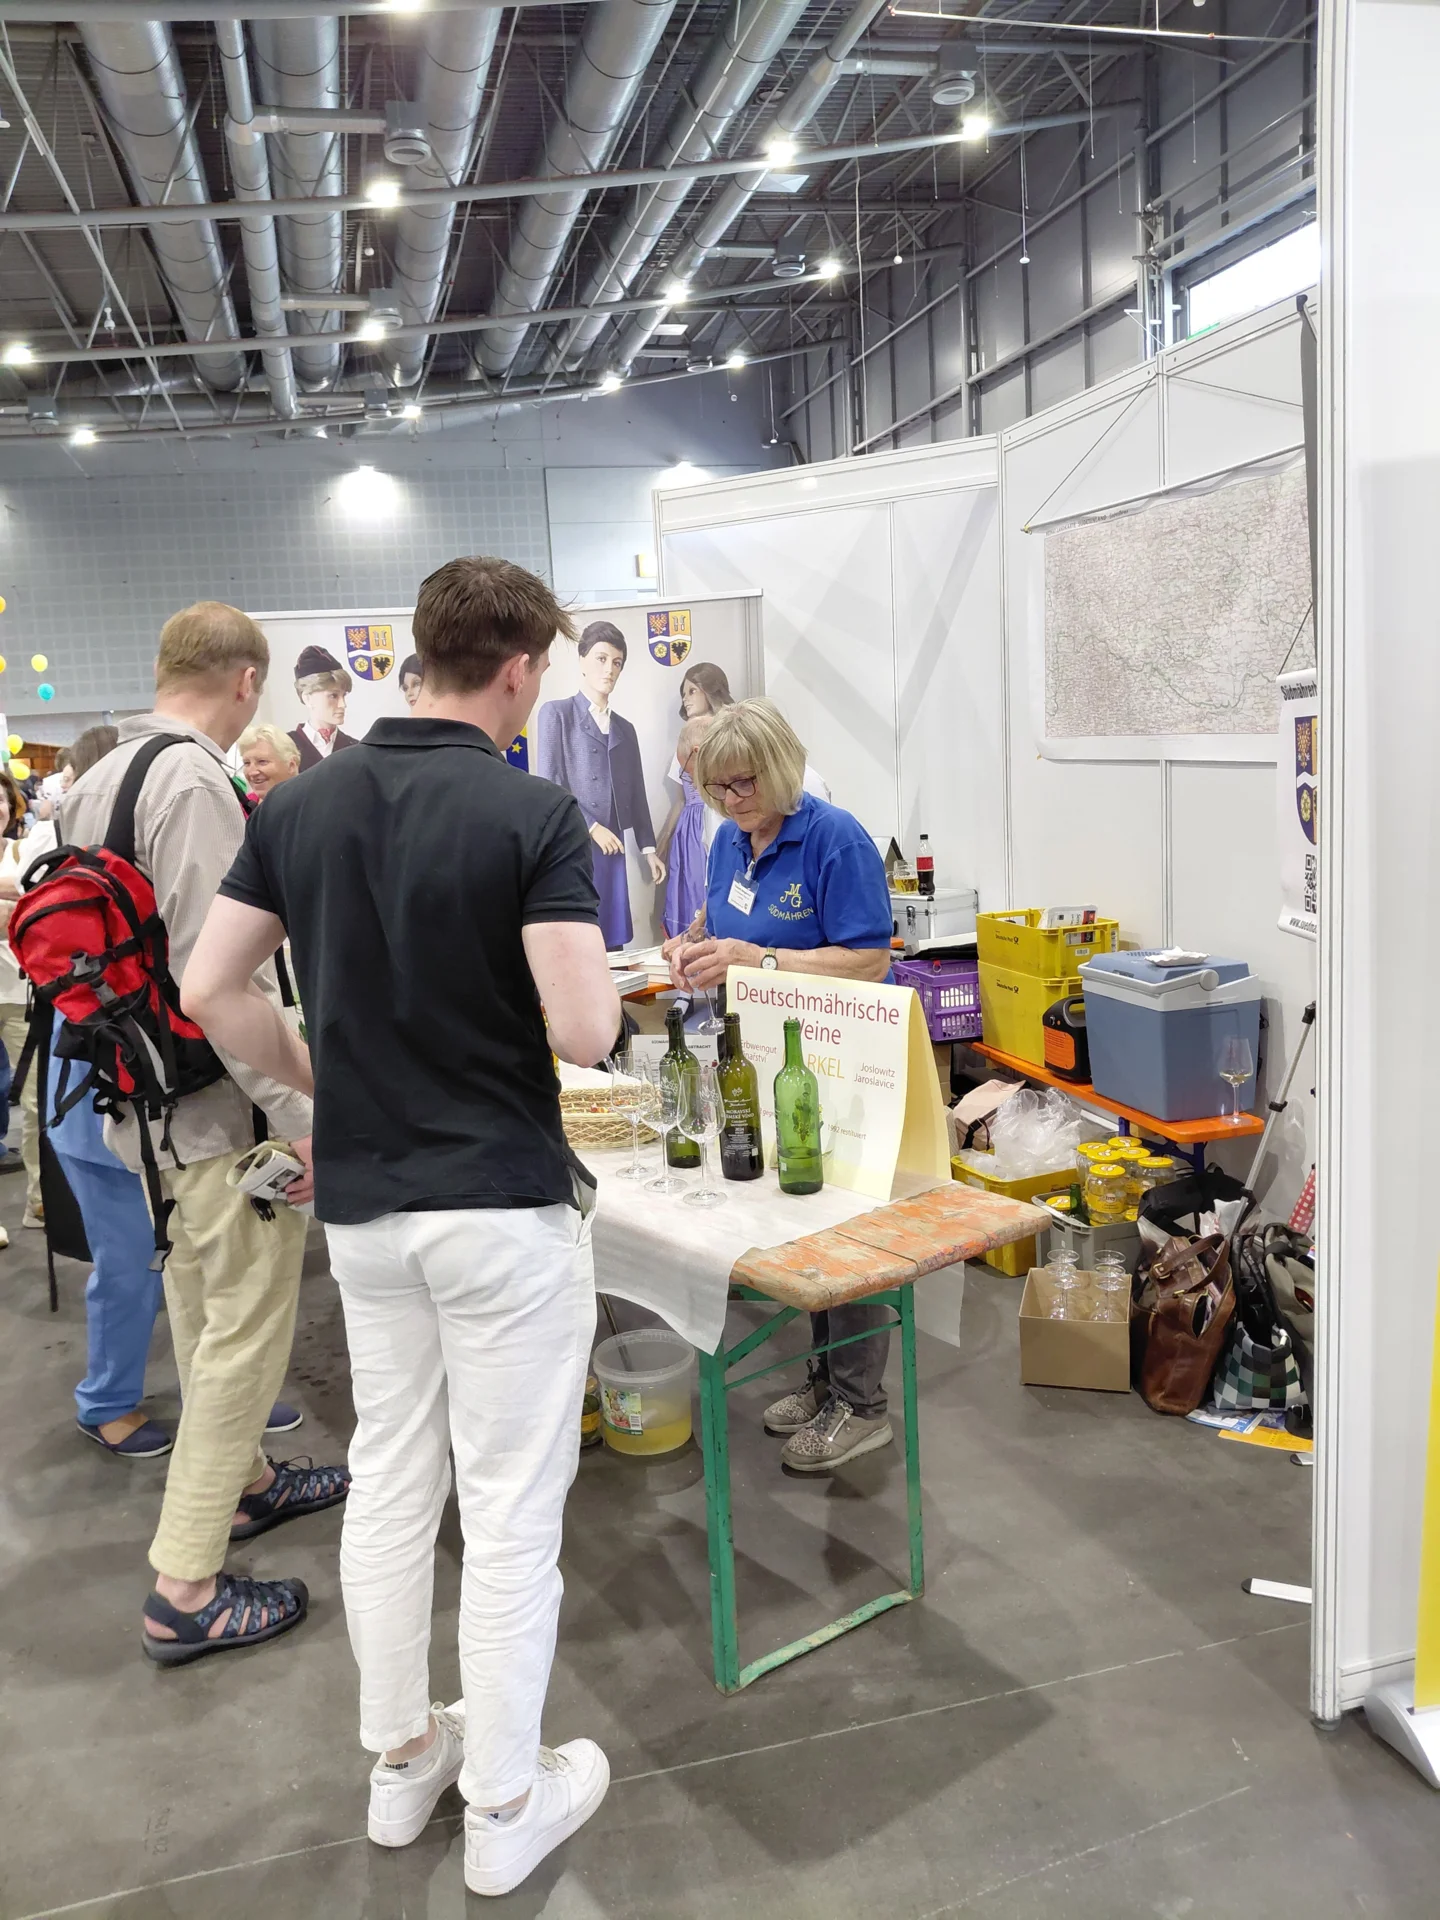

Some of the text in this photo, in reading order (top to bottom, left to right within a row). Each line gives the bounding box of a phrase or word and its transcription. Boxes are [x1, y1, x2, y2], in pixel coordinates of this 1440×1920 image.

[768, 903, 814, 921] SÜDMÄHREN
[736, 981, 900, 1025] Deutschmährische
[743, 1051, 767, 1063] nařství
[861, 1063, 895, 1078] Joslowitz
[854, 1073, 895, 1090] Jaroslavice
